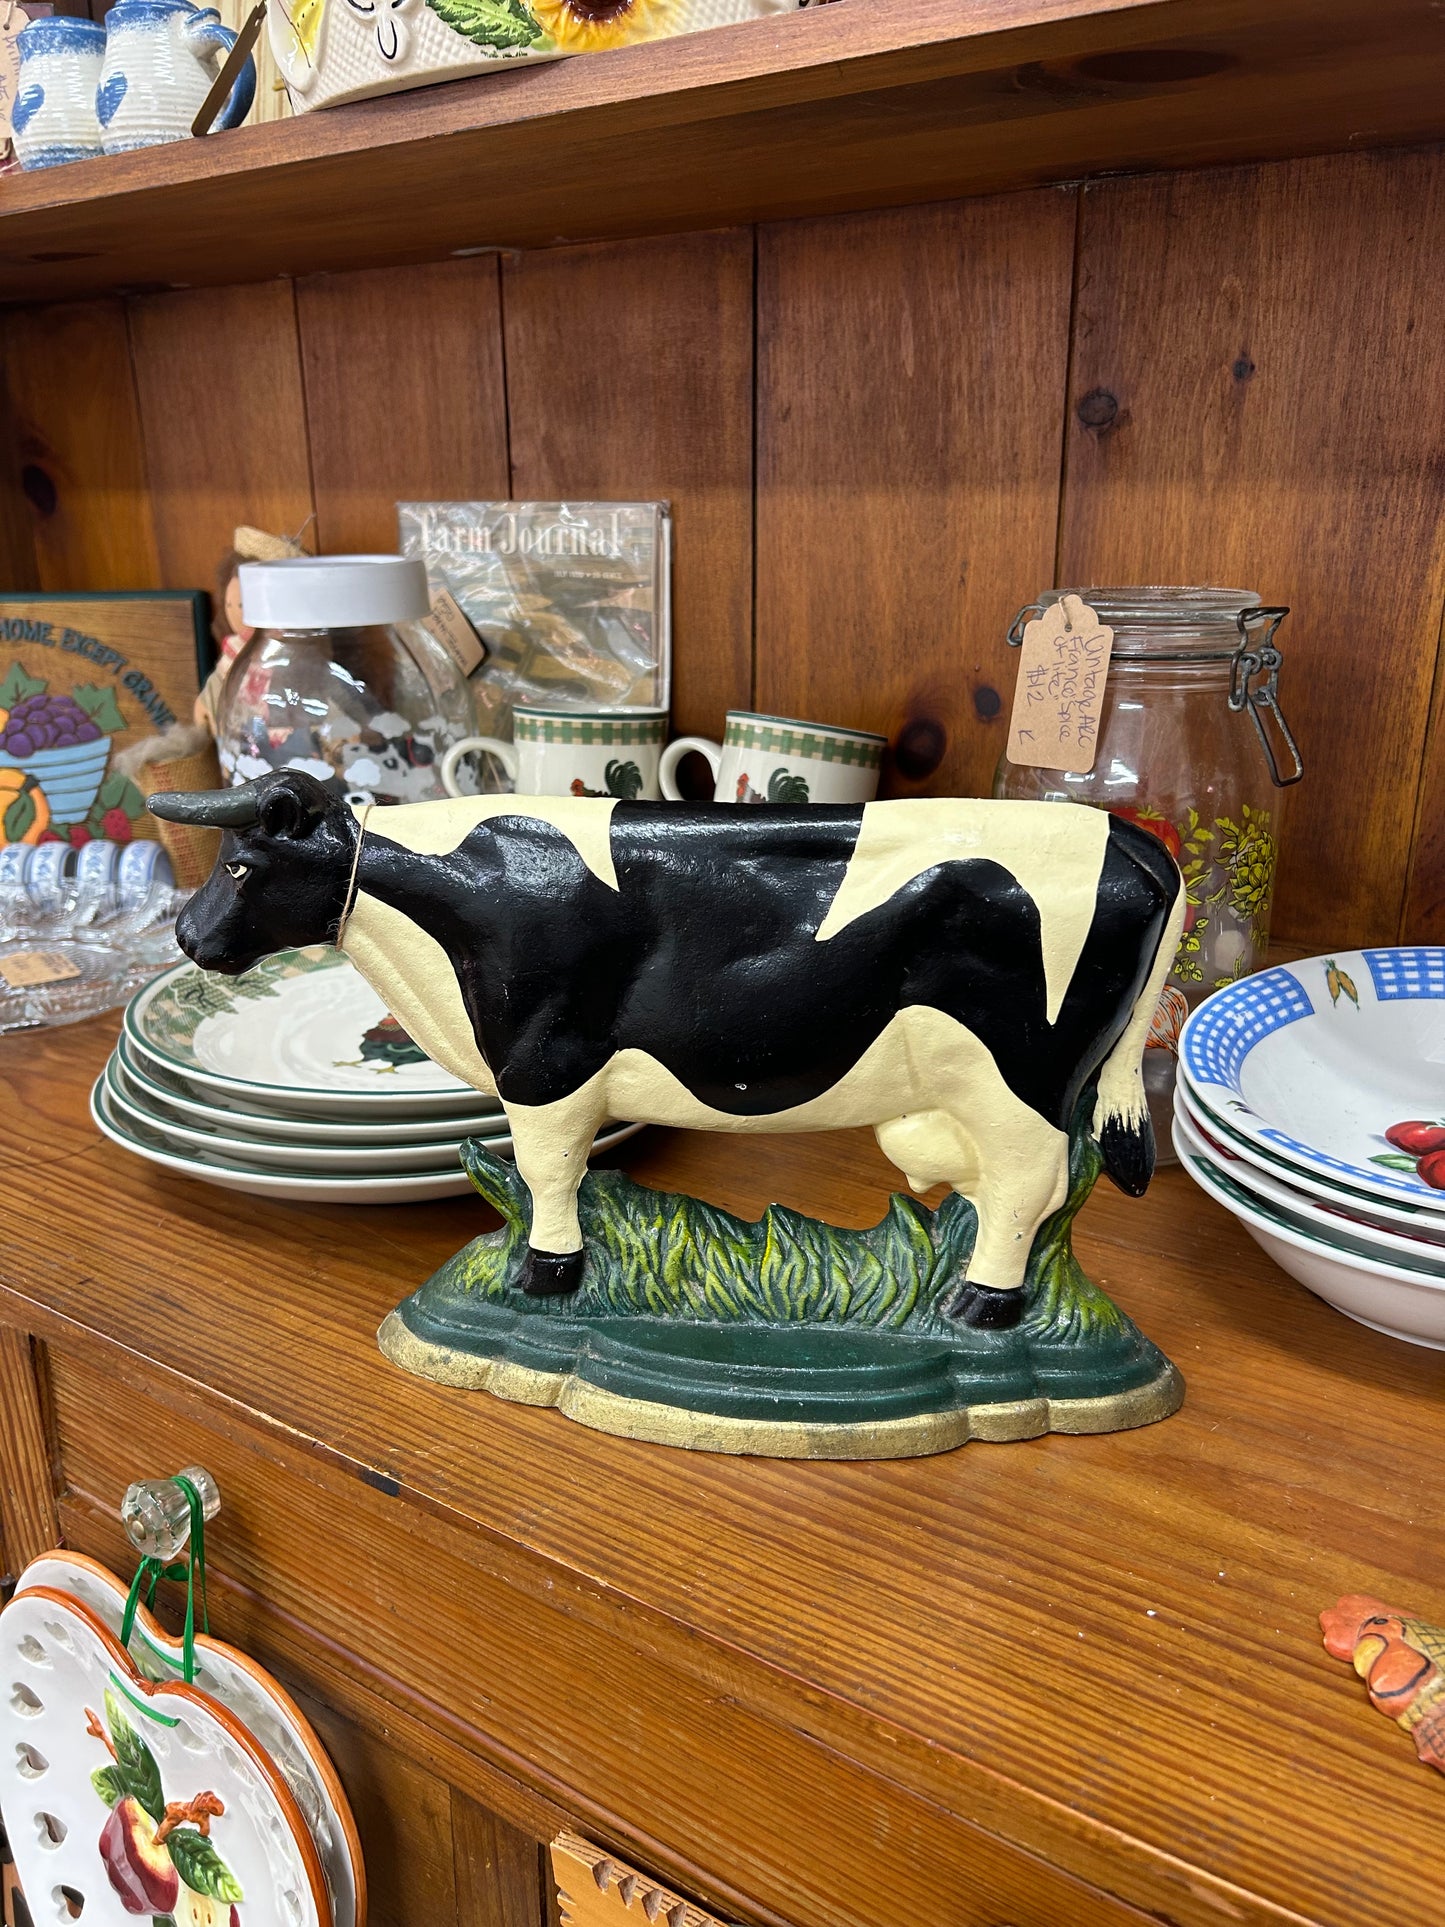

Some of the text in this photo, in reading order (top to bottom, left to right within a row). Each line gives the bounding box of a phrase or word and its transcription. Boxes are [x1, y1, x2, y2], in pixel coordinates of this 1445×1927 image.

[499, 512, 623, 559] Journal
[61, 627, 128, 674] EXCEPT
[1026, 664, 1050, 707] $12
[1018, 729, 1035, 745] K
[1077, 714, 1096, 748] ARC
